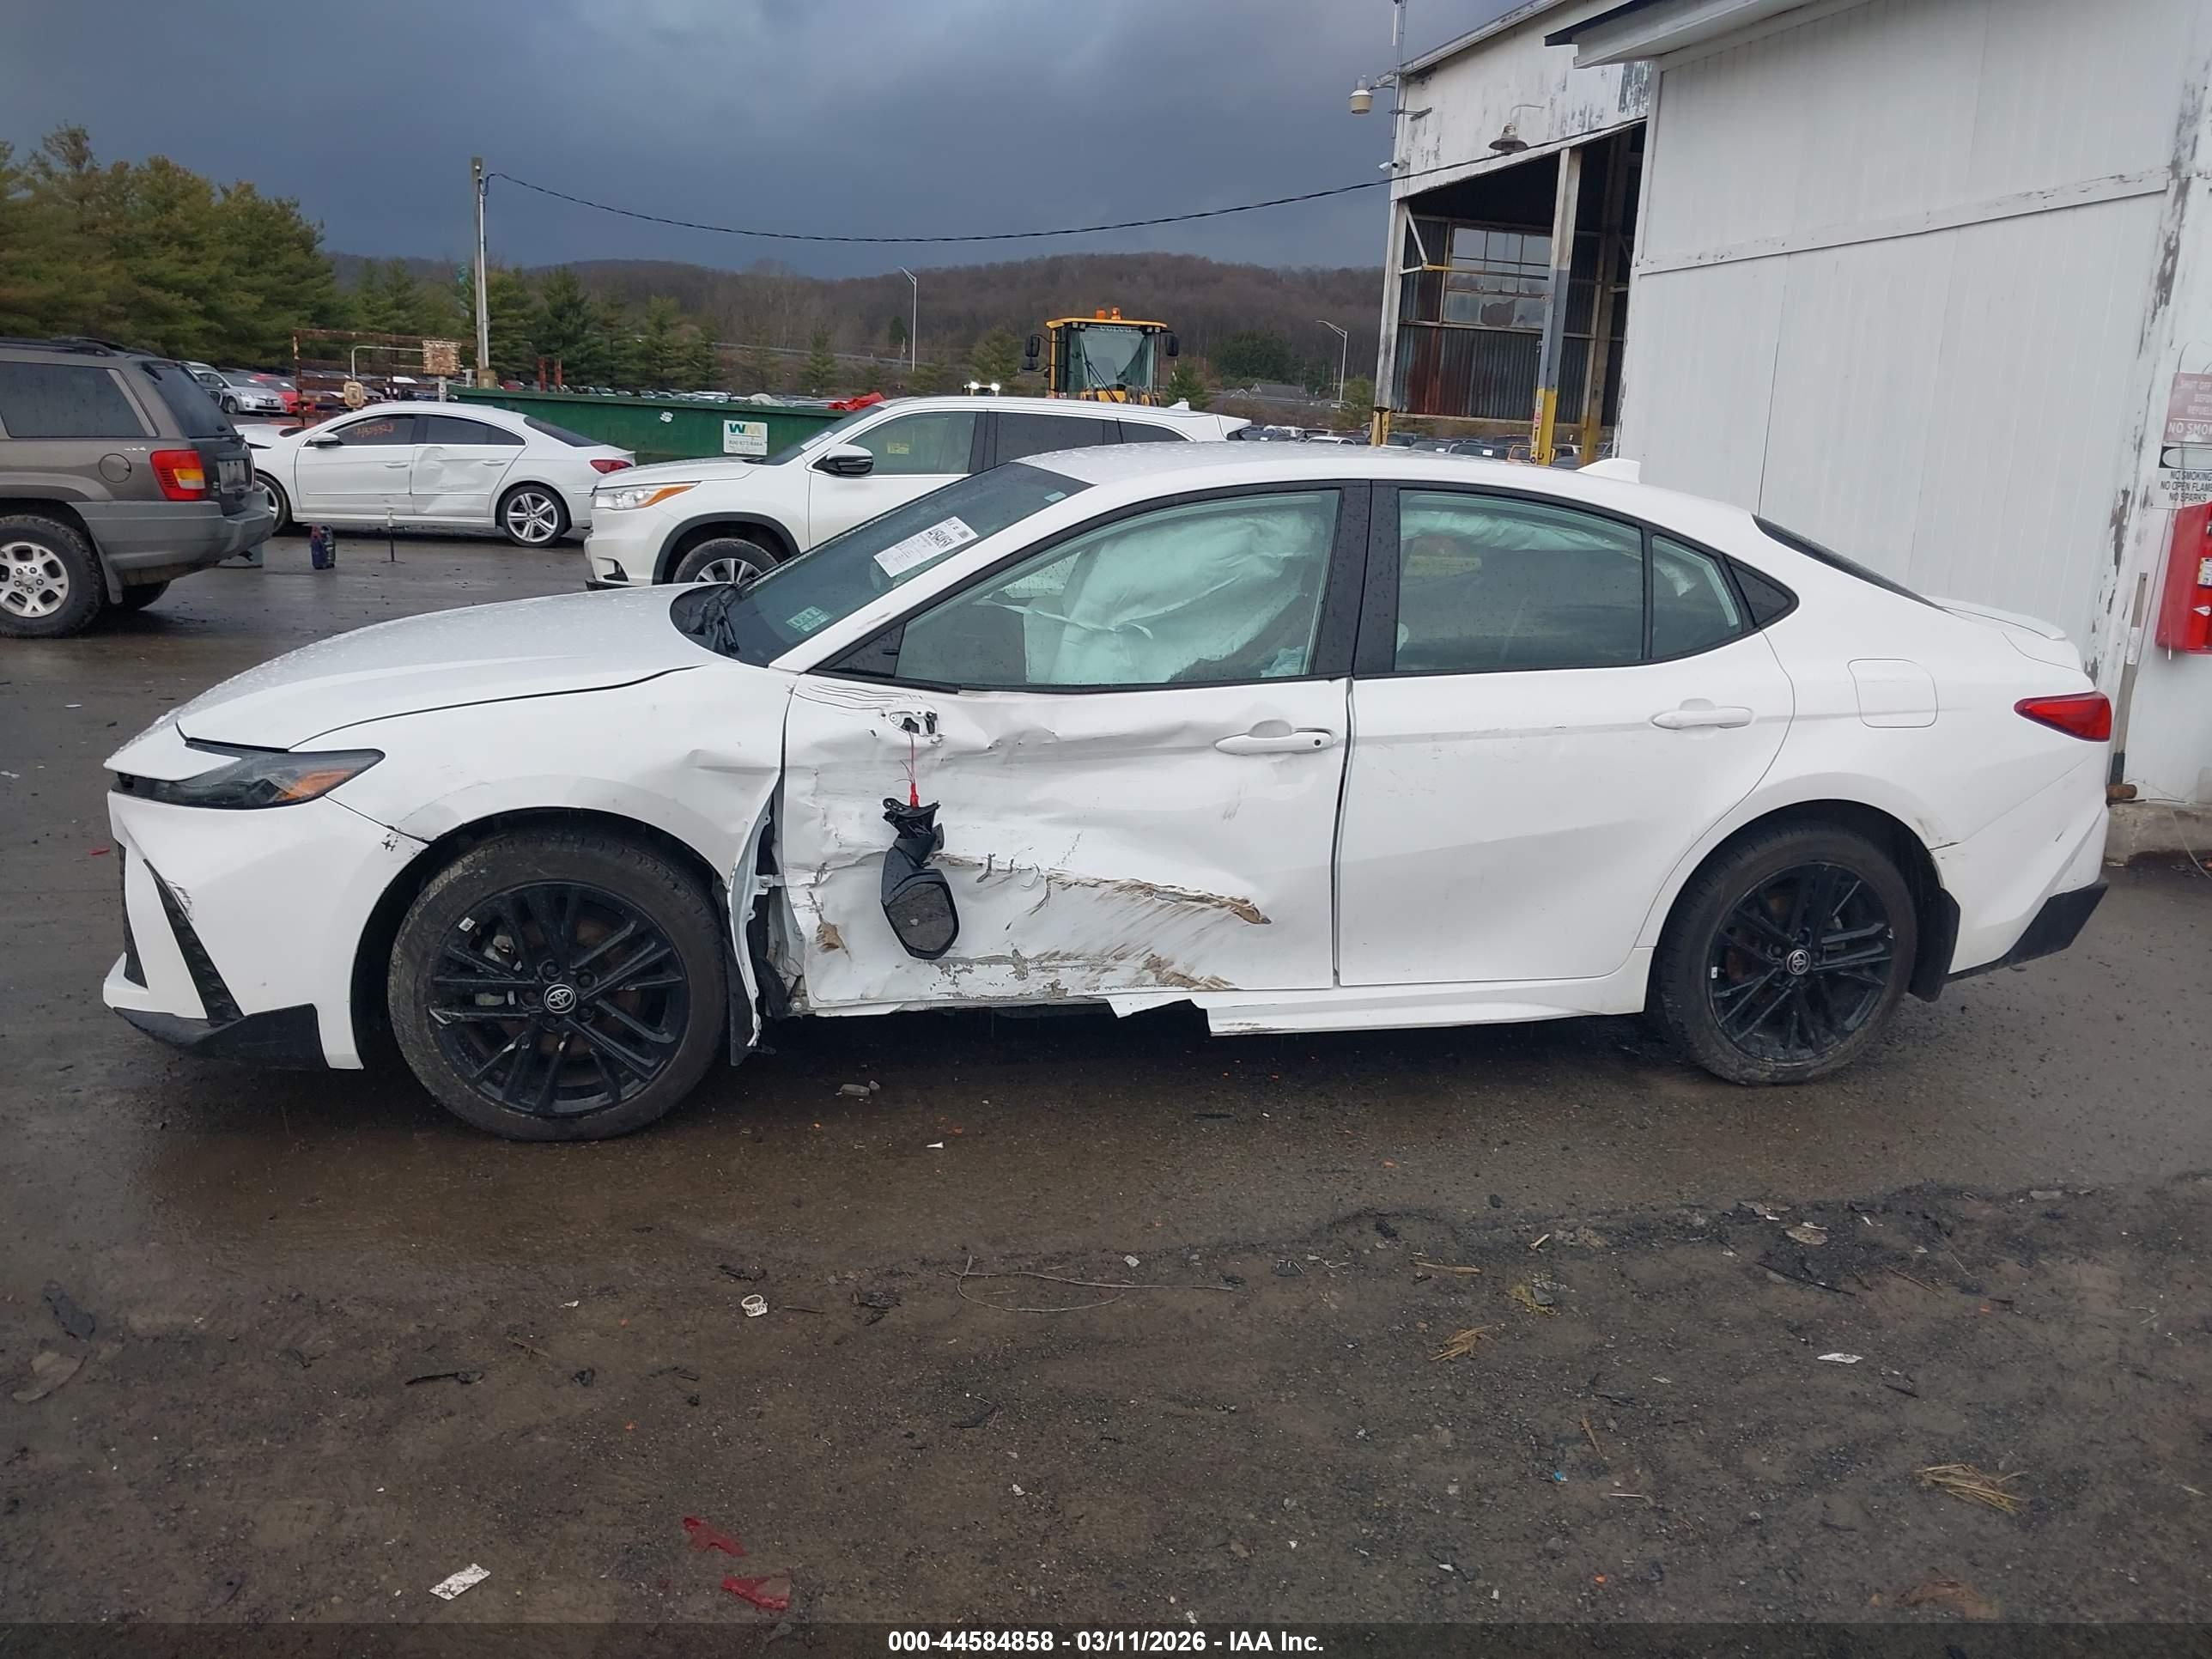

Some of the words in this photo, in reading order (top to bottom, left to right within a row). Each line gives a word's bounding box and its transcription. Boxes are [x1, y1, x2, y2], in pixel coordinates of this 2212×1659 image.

[728, 423, 762, 435] WM
[2167, 422, 2184, 434] NO
[2170, 470, 2180, 480] NO
[2160, 480, 2171, 490] NO
[2172, 481, 2191, 491] OPEN
[2169, 492, 2179, 501] NO
[2180, 493, 2207, 502] SPARKS
